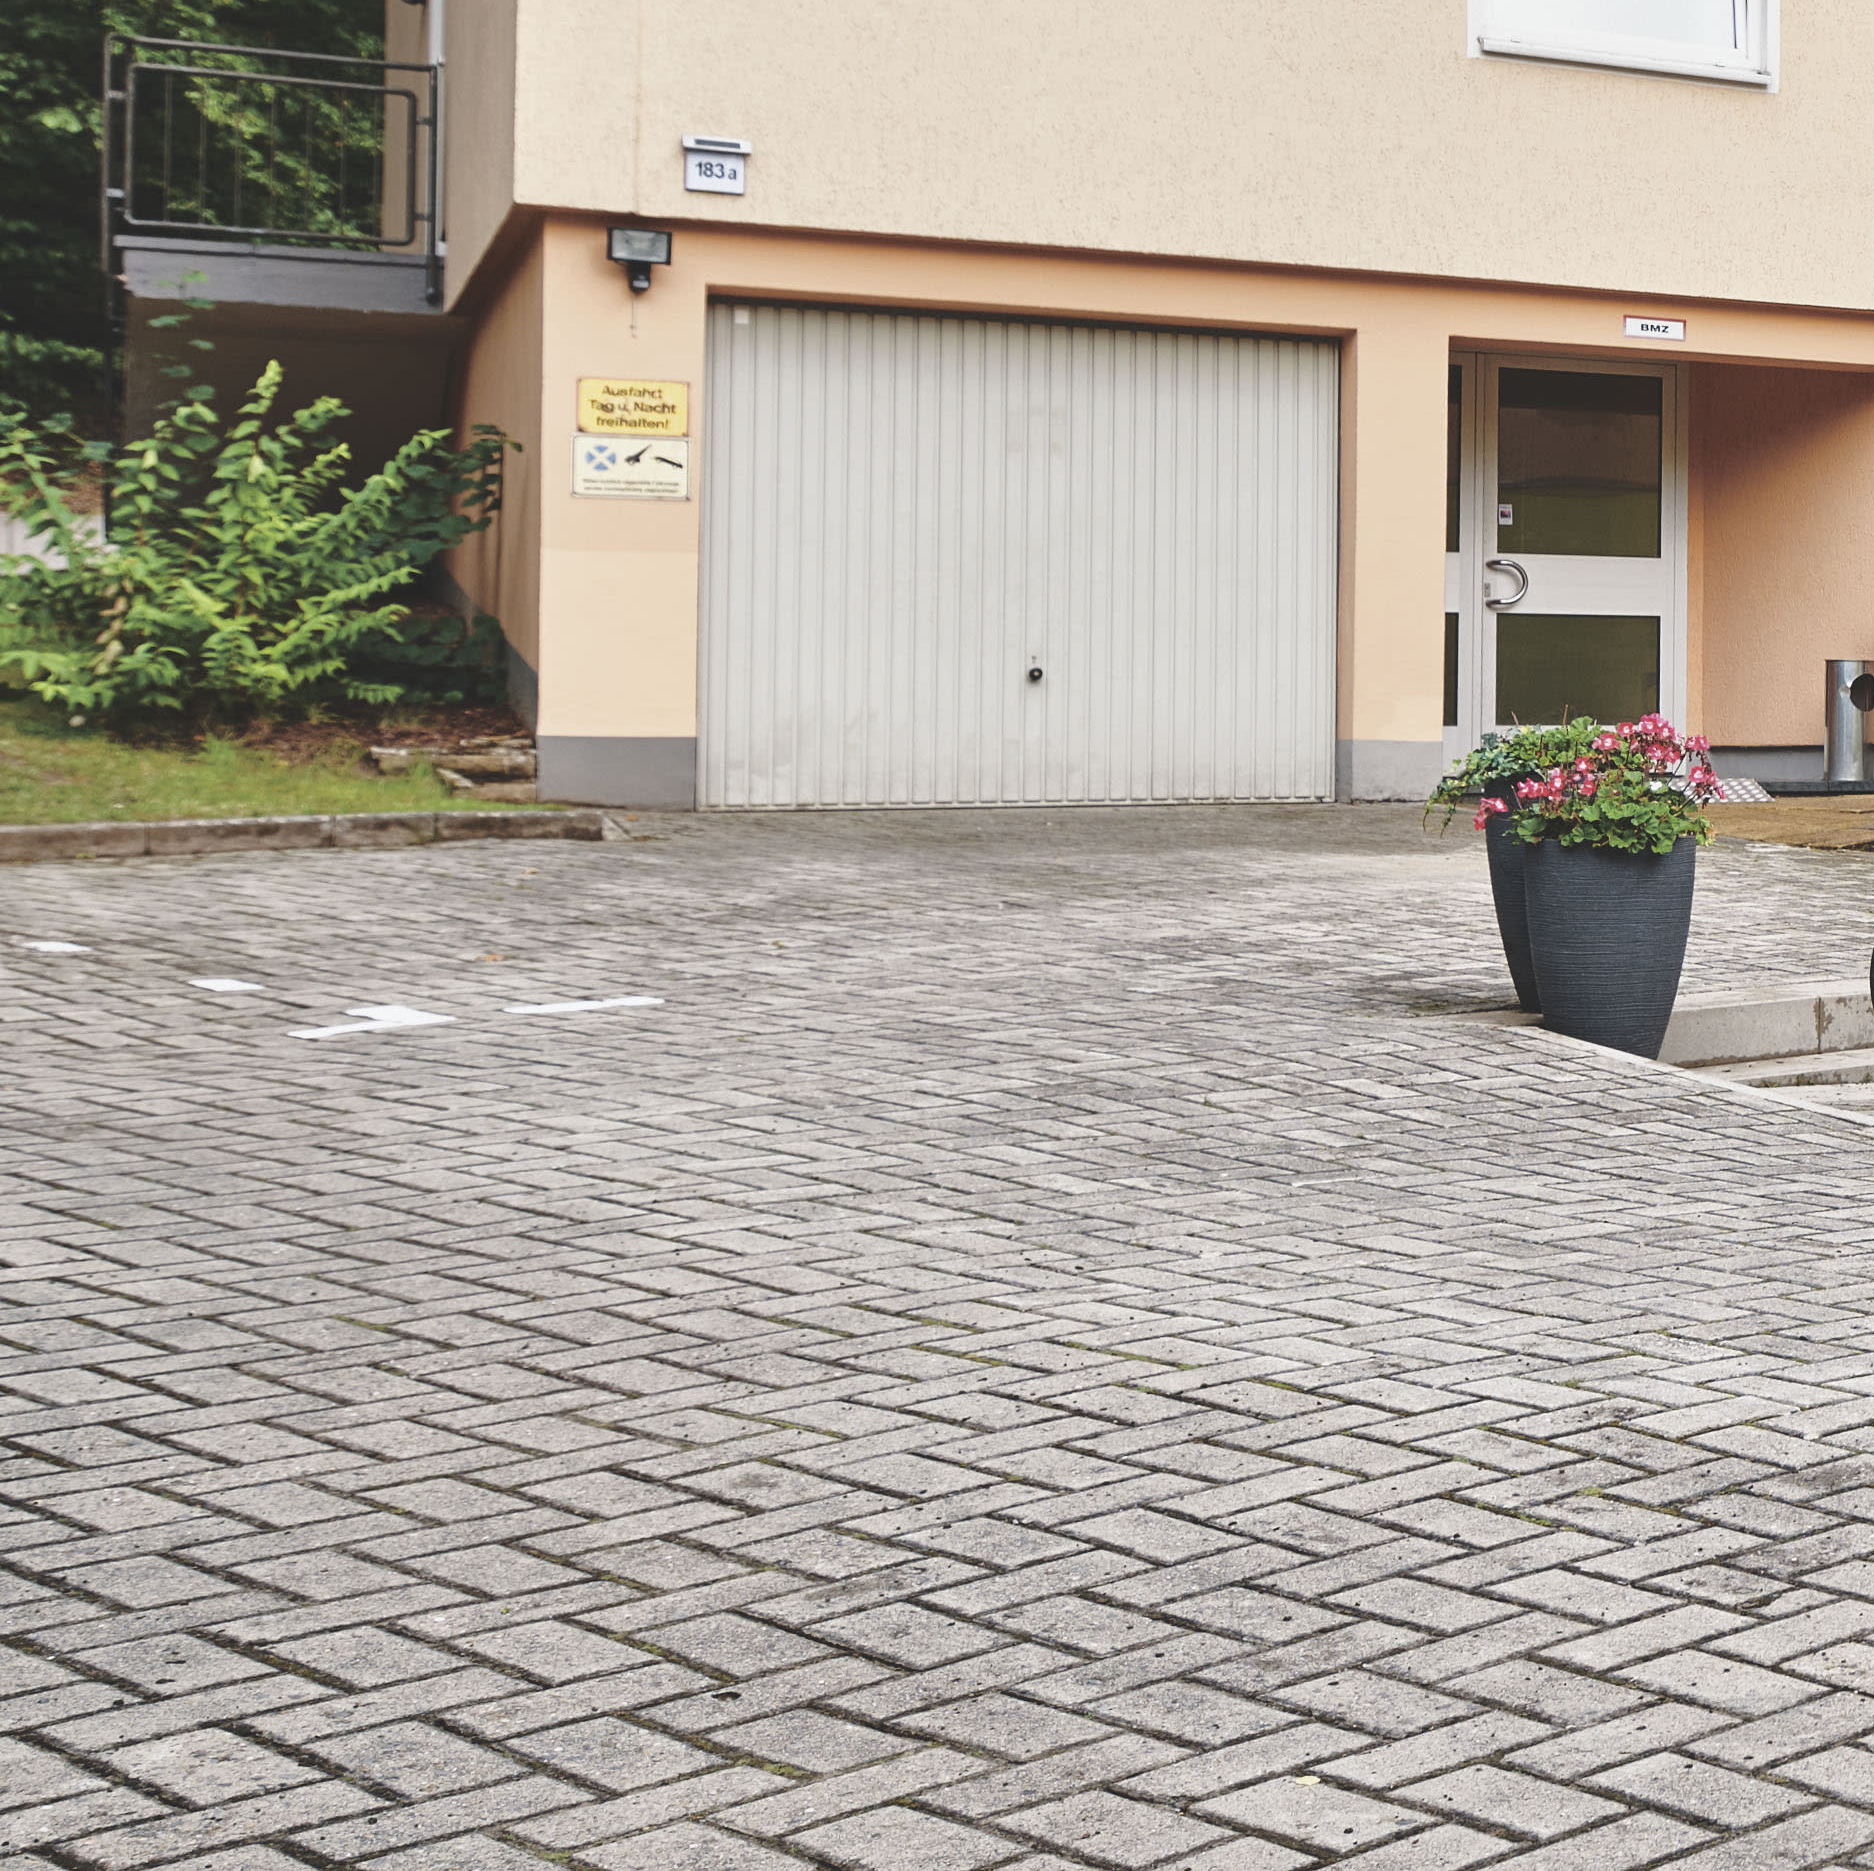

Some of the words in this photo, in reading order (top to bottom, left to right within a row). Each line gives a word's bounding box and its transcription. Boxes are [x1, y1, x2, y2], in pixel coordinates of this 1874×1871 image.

[695, 161, 725, 179] 183
[728, 168, 737, 180] a
[1640, 323, 1669, 333] BMZ
[602, 385, 663, 399] Ausfahrt
[590, 399, 615, 413] Tag
[633, 401, 677, 414] Nacht
[596, 416, 669, 430] freihalten!
